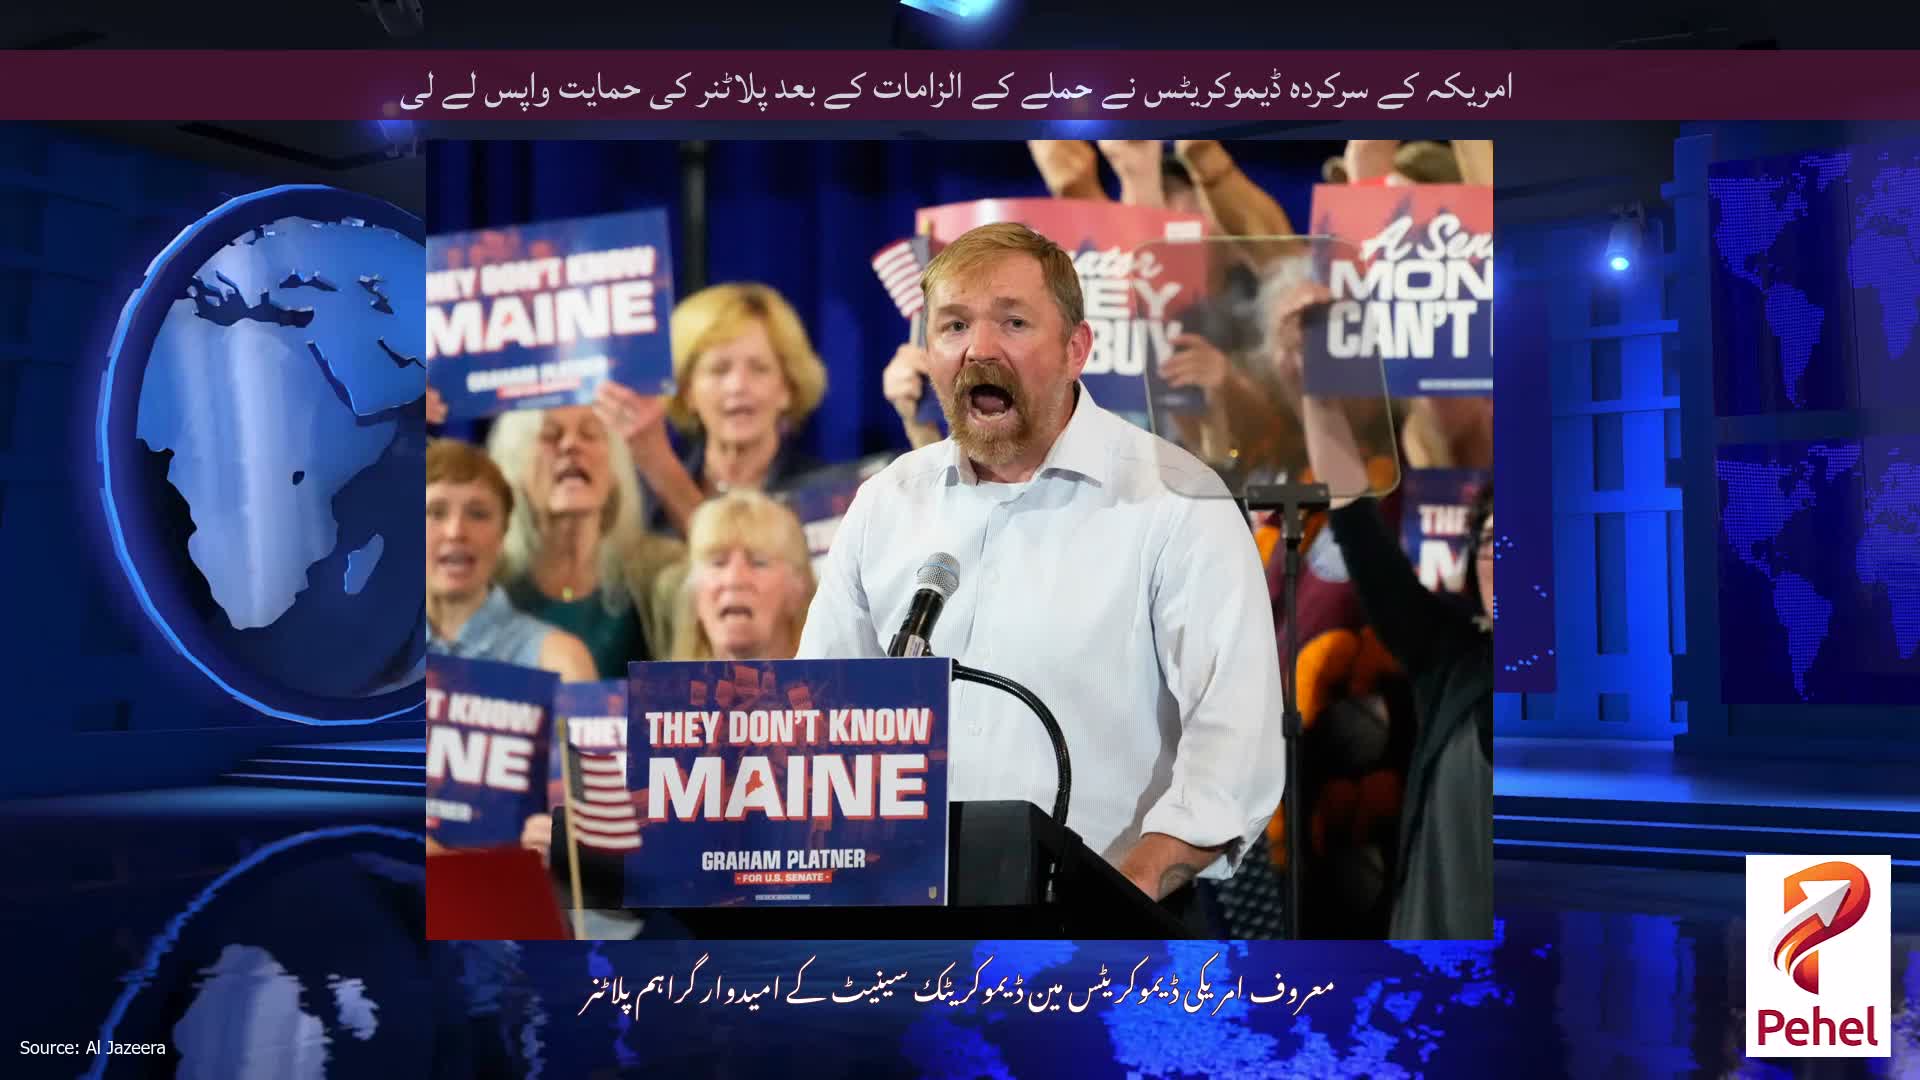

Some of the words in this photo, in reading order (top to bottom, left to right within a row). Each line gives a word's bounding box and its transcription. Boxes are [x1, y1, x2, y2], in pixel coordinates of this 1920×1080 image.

[1358, 215, 1415, 262] A
[565, 245, 656, 285] KNOW
[1329, 260, 1493, 302] MON
[426, 280, 657, 359] MAINE
[1081, 277, 1183, 320] EY
[1328, 300, 1478, 360] CAN'T
[645, 711, 721, 745] THEY
[729, 709, 820, 744] DON'T
[828, 707, 932, 744] KNOW
[648, 753, 928, 820] MAINE
[701, 850, 781, 871] GRAHAM
[786, 848, 866, 870] PLATNER
[742, 873, 763, 884] FOR
[764, 873, 784, 883] U.S.
[785, 872, 824, 883] SENATE
